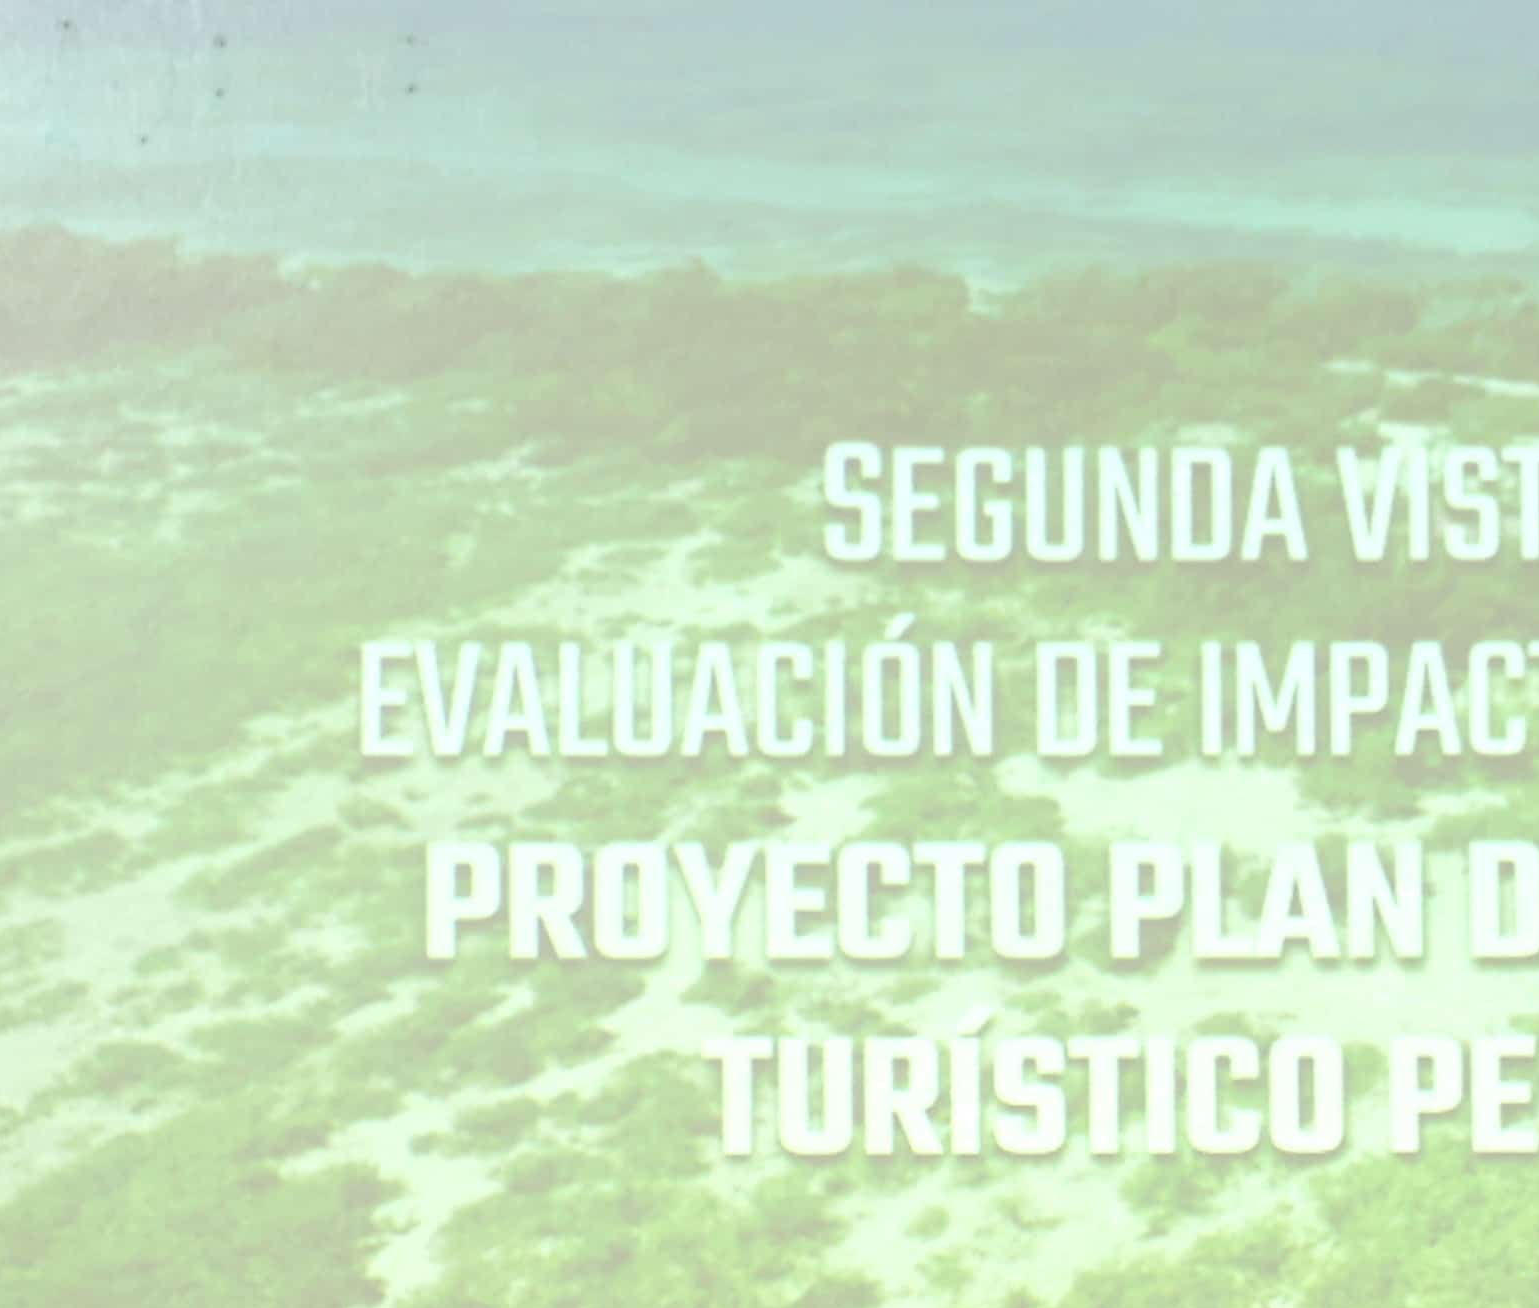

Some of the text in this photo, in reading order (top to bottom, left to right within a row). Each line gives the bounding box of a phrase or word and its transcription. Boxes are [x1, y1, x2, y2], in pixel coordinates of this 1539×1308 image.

[823, 441, 1309, 562] SEGUNDA
[360, 613, 996, 758] EVALUACIÓN
[1036, 640, 1163, 757] DE
[425, 840, 1065, 961] PROYECTO
[1109, 839, 1425, 961] PLAN
[705, 1006, 1345, 1156] TURÍSTICO
